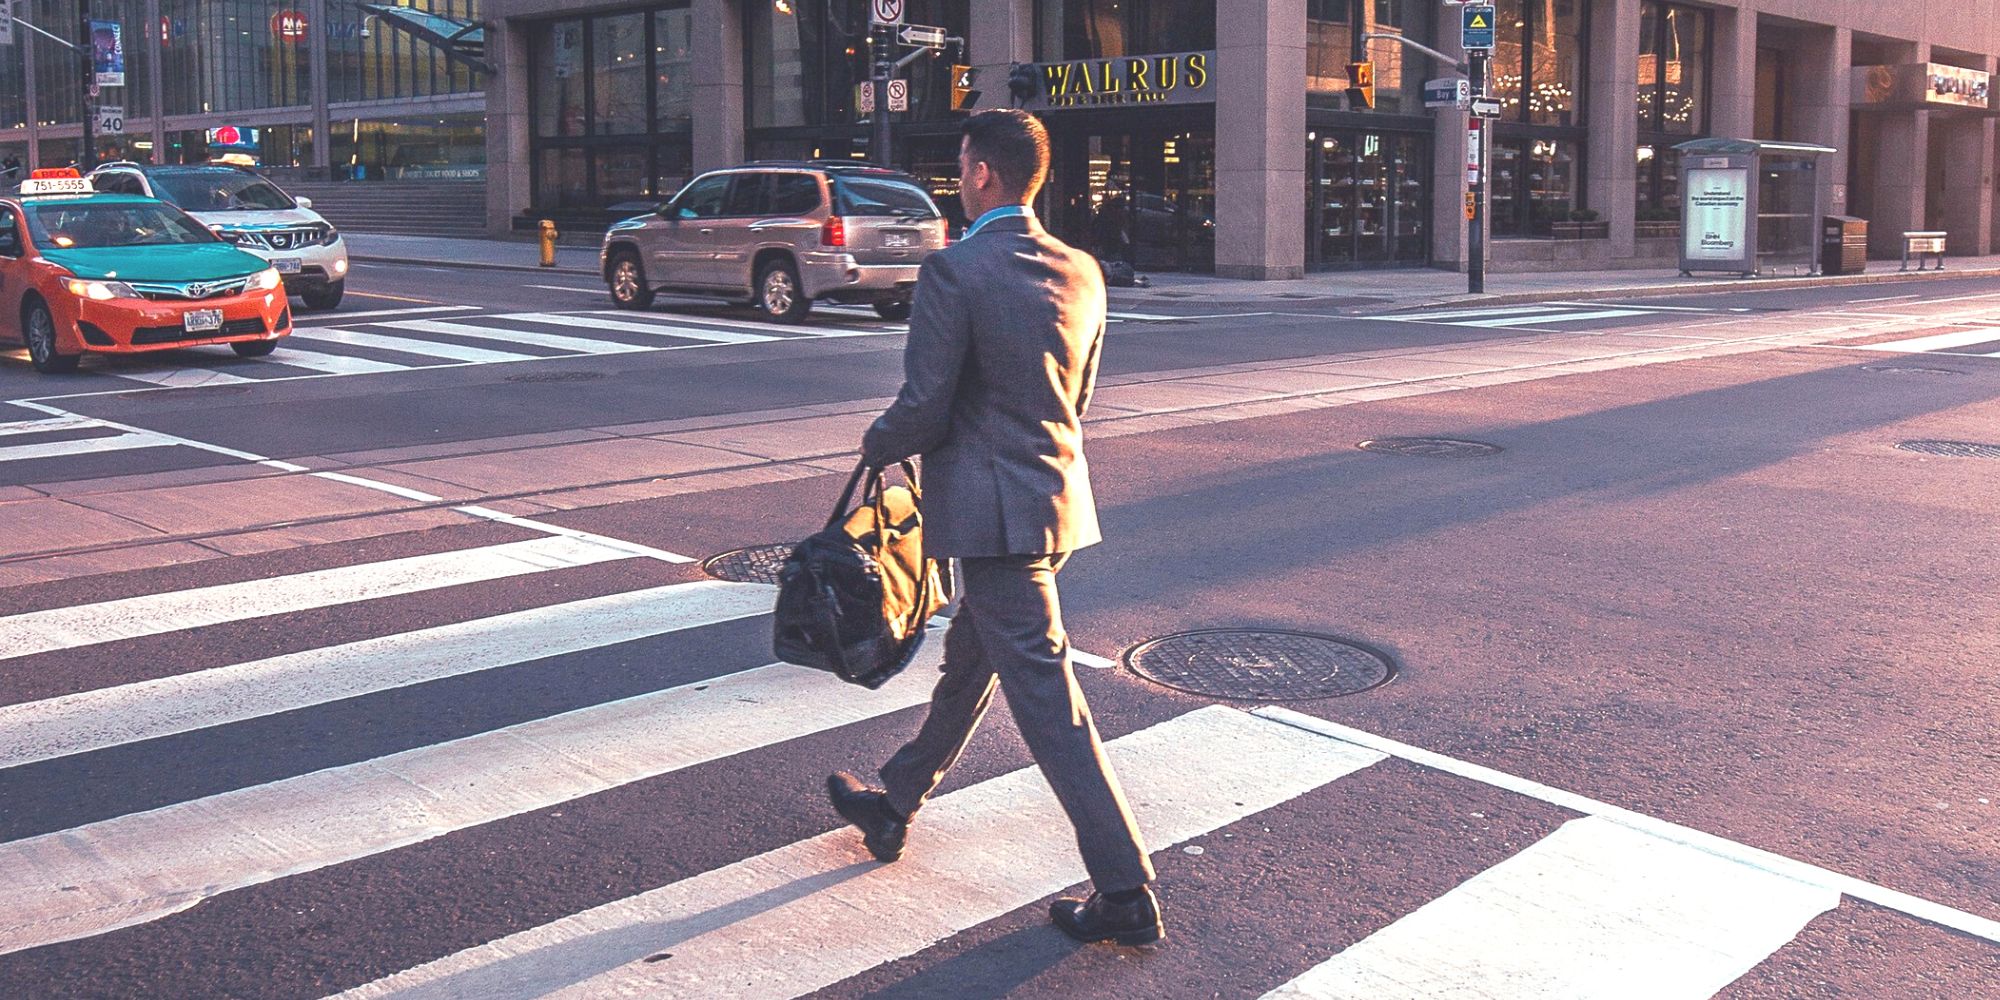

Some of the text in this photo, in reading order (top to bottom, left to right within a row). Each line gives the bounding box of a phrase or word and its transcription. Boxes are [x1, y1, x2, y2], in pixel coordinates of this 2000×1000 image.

[1040, 53, 1206, 95] WALRUS
[102, 117, 122, 132] 40
[41, 170, 72, 178] BECK
[33, 180, 84, 191] 751-5555
[1701, 239, 1734, 247] Bloomberg
